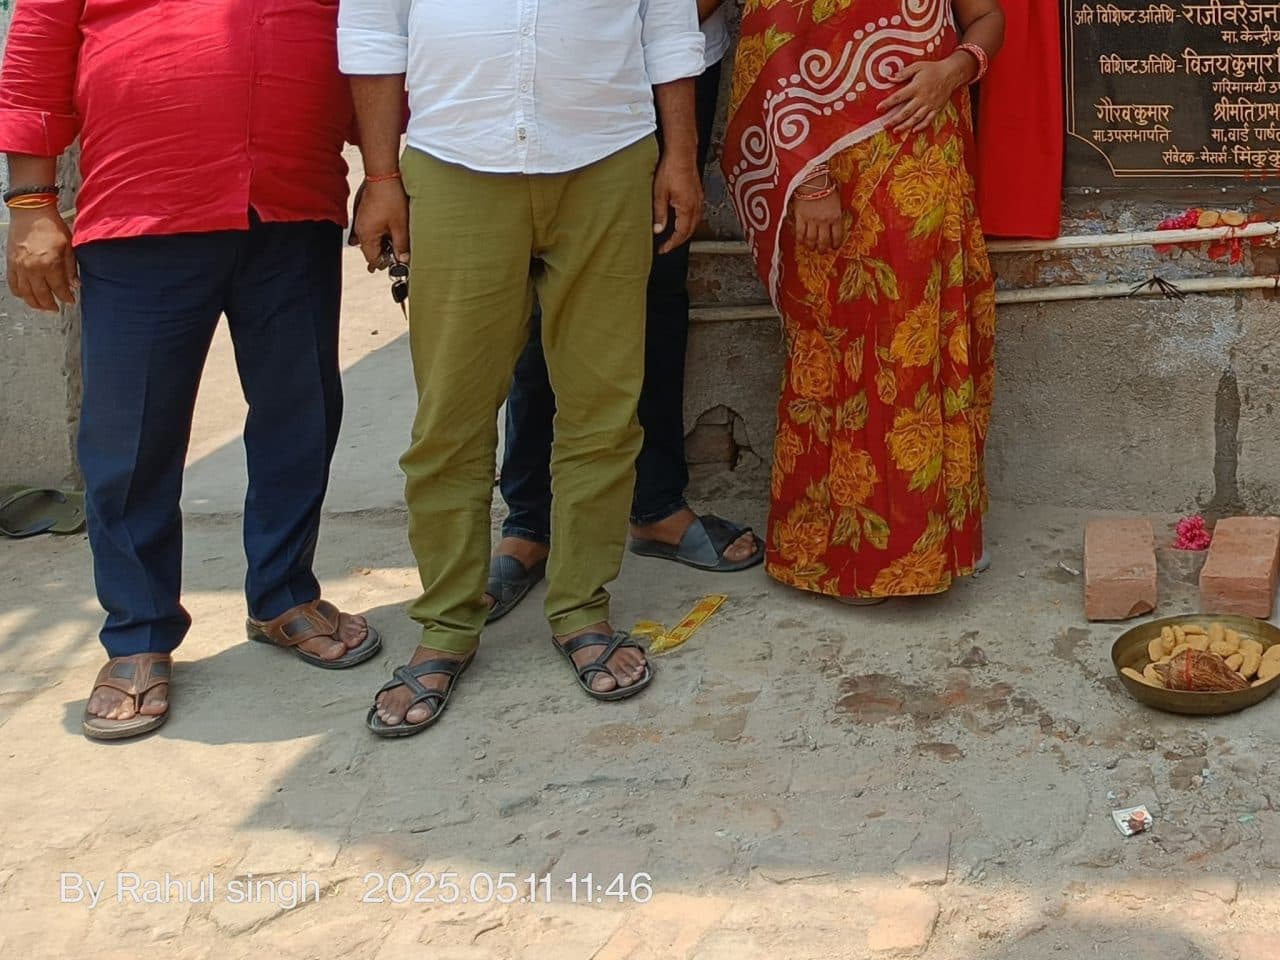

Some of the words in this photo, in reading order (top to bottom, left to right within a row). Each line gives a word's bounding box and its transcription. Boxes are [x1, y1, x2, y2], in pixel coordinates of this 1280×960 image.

[1074, 3, 1094, 25] अति
[1096, 3, 1137, 26] विशिष्ट
[1098, 53, 1139, 75] विशिष्ट
[1181, 47, 1232, 75] विजय
[1232, 54, 1274, 78] कुमार
[1212, 76, 1268, 94] गरिमामयी
[1093, 96, 1132, 123] गौरव
[1132, 103, 1174, 126] कुमार
[1213, 96, 1255, 122] श्रीमति
